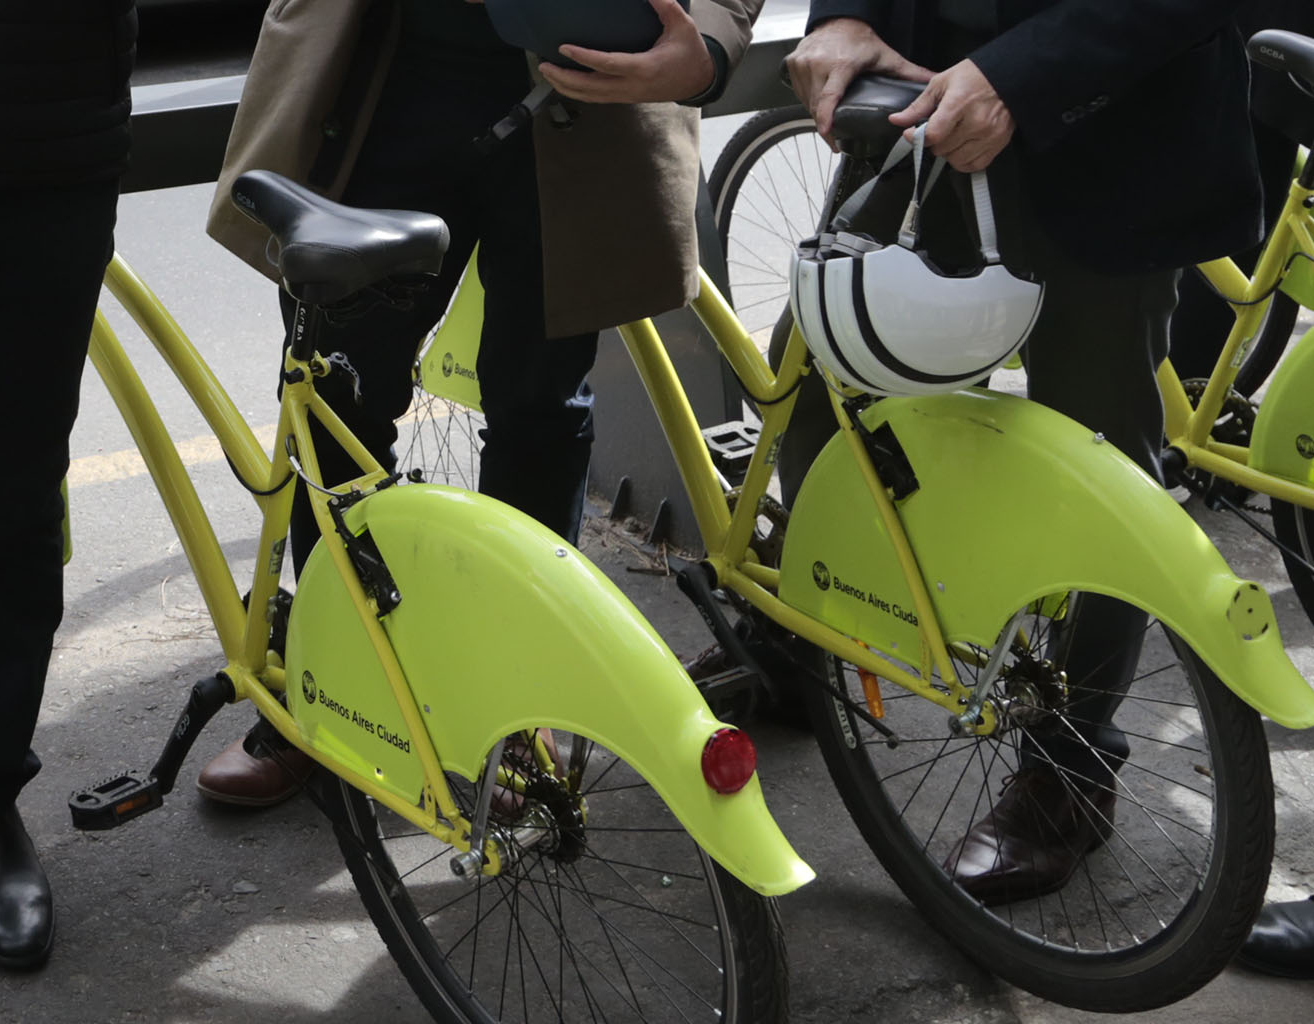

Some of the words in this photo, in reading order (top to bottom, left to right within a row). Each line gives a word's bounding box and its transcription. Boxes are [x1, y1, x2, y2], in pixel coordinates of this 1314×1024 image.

[1259, 46, 1285, 61] GCBA
[833, 576, 866, 602] Buenos
[867, 592, 891, 614] Aires
[892, 604, 919, 627] Ciuda
[318, 689, 350, 720] Buenos
[351, 711, 375, 734] Aires
[376, 724, 411, 753] Ciudad
